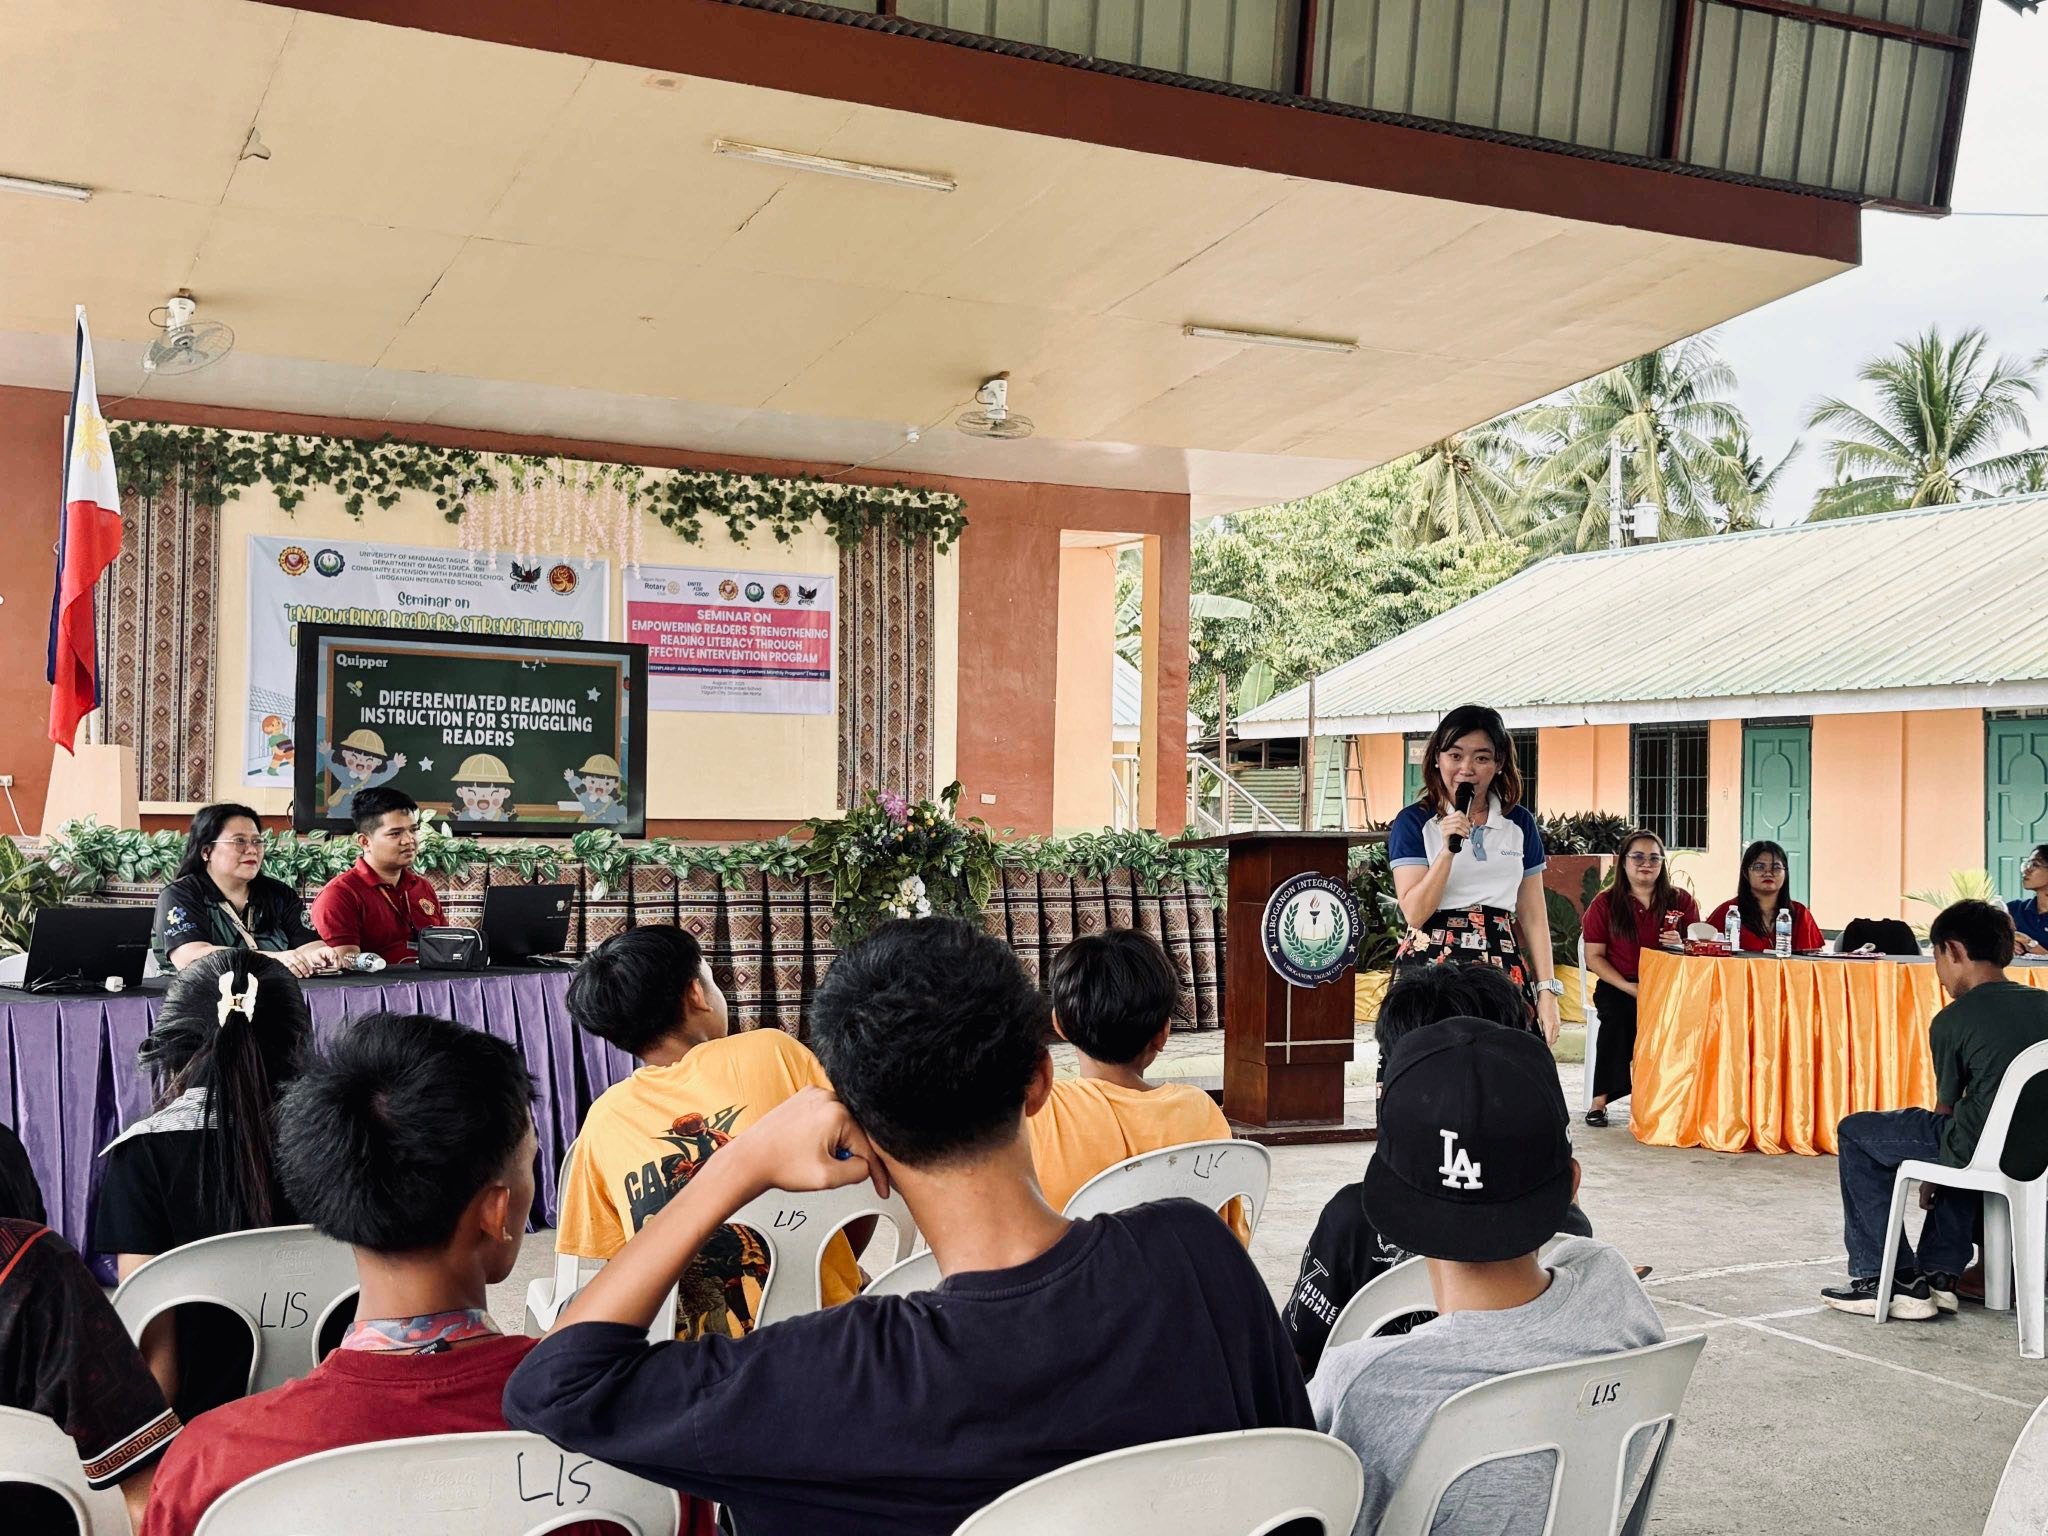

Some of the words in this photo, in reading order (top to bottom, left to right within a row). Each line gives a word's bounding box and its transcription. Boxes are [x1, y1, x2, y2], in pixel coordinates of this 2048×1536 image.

[359, 551, 397, 559] UNIVERSITY
[408, 555, 444, 563] MINDANAO
[372, 559, 416, 568] DEPARTMENT
[428, 563, 447, 571] BASIC
[448, 564, 485, 573] EDUCAION
[351, 565, 391, 574] COMMUNITY
[392, 568, 429, 576] EXTENSION
[415, 577, 456, 585] INTEGRATED
[457, 579, 483, 587] SCHOOL
[644, 583, 666, 591] Rotary
[397, 591, 451, 608] Seminar
[455, 598, 470, 609] on
[697, 609, 751, 622] SEMINAR
[753, 612, 772, 624] ON
[632, 620, 702, 634] EMPOWERING
[704, 624, 748, 636] READERS
[750, 626, 828, 639] STRENGTHENING
[660, 634, 705, 647] READING
[707, 636, 753, 649] LITERACY
[755, 638, 803, 650] THROUGH
[336, 653, 389, 670] Quipper
[648, 647, 695, 658] FFECTIVE
[696, 648, 768, 662] INTERVENTION
[769, 650, 818, 664] PROGRAM
[379, 690, 507, 712] DIFFERENTIATED
[510, 696, 577, 715] READING
[360, 707, 463, 727] INSTRUCTION
[466, 711, 497, 729] FOR
[501, 713, 593, 733] STRUGGLING
[442, 728, 515, 747] READERS
[1269, 885, 1296, 938] LIBOGANON
[1297, 878, 1347, 900] INTEGRATED
[1344, 898, 1359, 938] SCHOOL
[1439, 1128, 1484, 1190] LA
[773, 1210, 808, 1231] LIS
[259, 1291, 309, 1329] LIS
[1591, 1382, 1621, 1407] LIS
[516, 1452, 593, 1507] LIS
